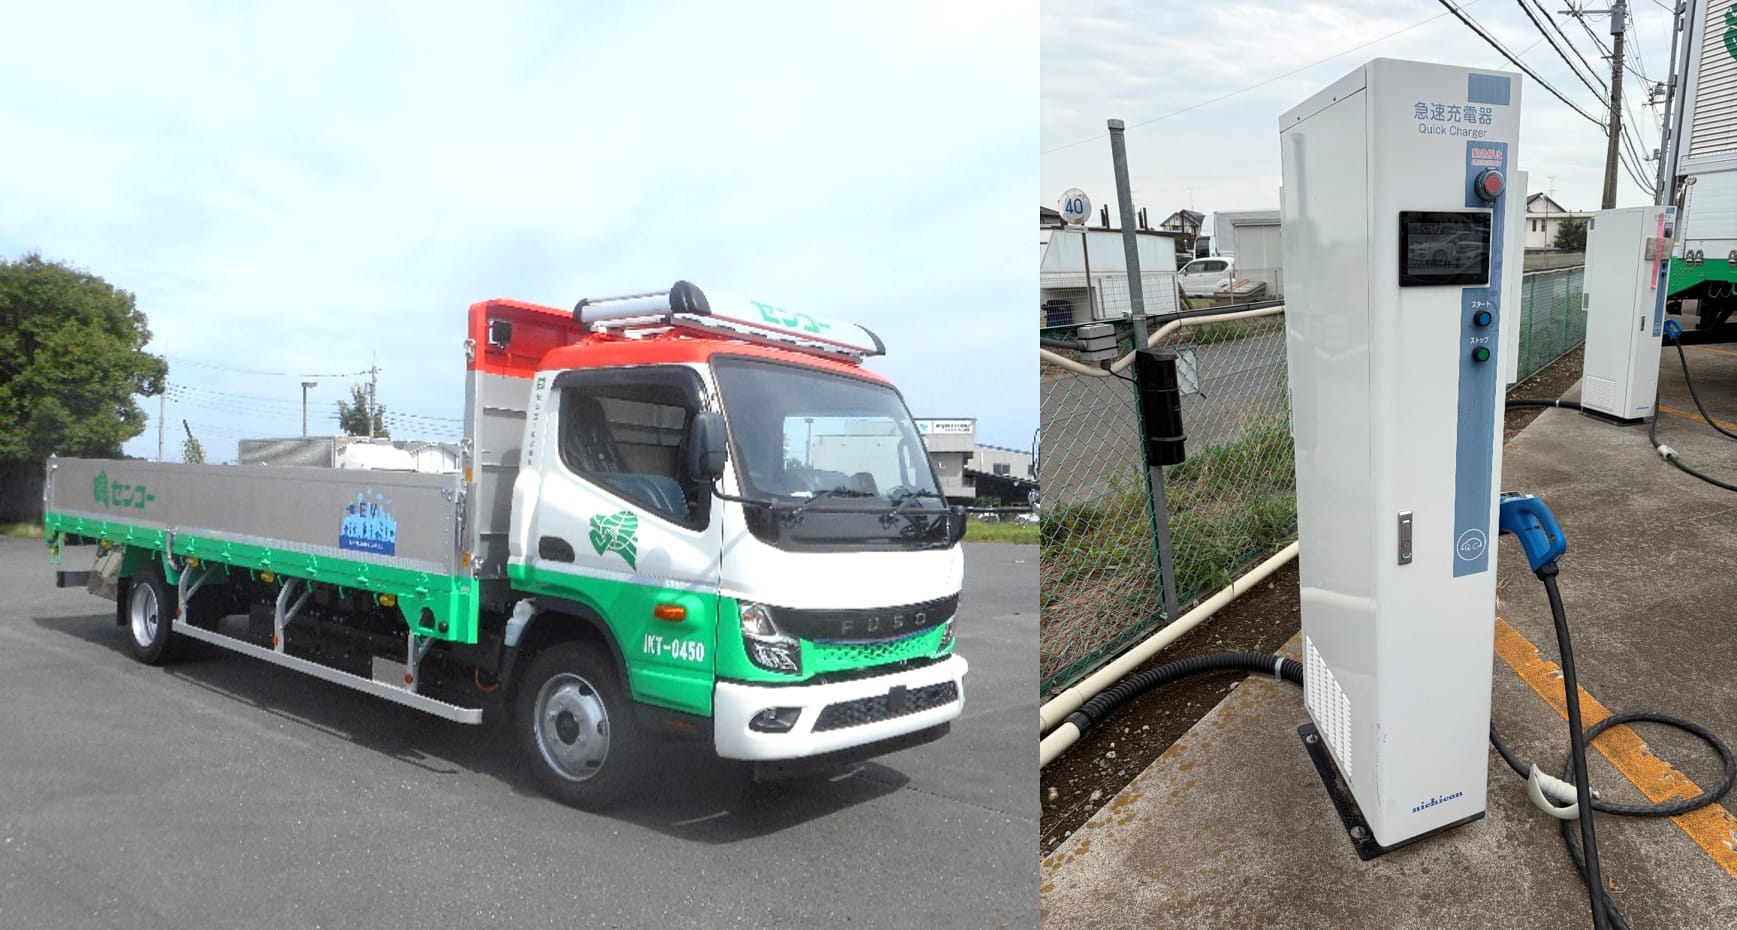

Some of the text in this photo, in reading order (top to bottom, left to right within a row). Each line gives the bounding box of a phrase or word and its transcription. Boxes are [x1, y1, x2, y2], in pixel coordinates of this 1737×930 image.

[1414, 101, 1492, 125] 急速充電器
[1418, 123, 1488, 139] Quick Charger
[1065, 198, 1084, 215] 40
[750, 300, 831, 333] センコー
[111, 480, 156, 509] センコー
[359, 502, 378, 519] EV
[841, 612, 926, 635] FUSO
[1412, 791, 1463, 813] nichicon
